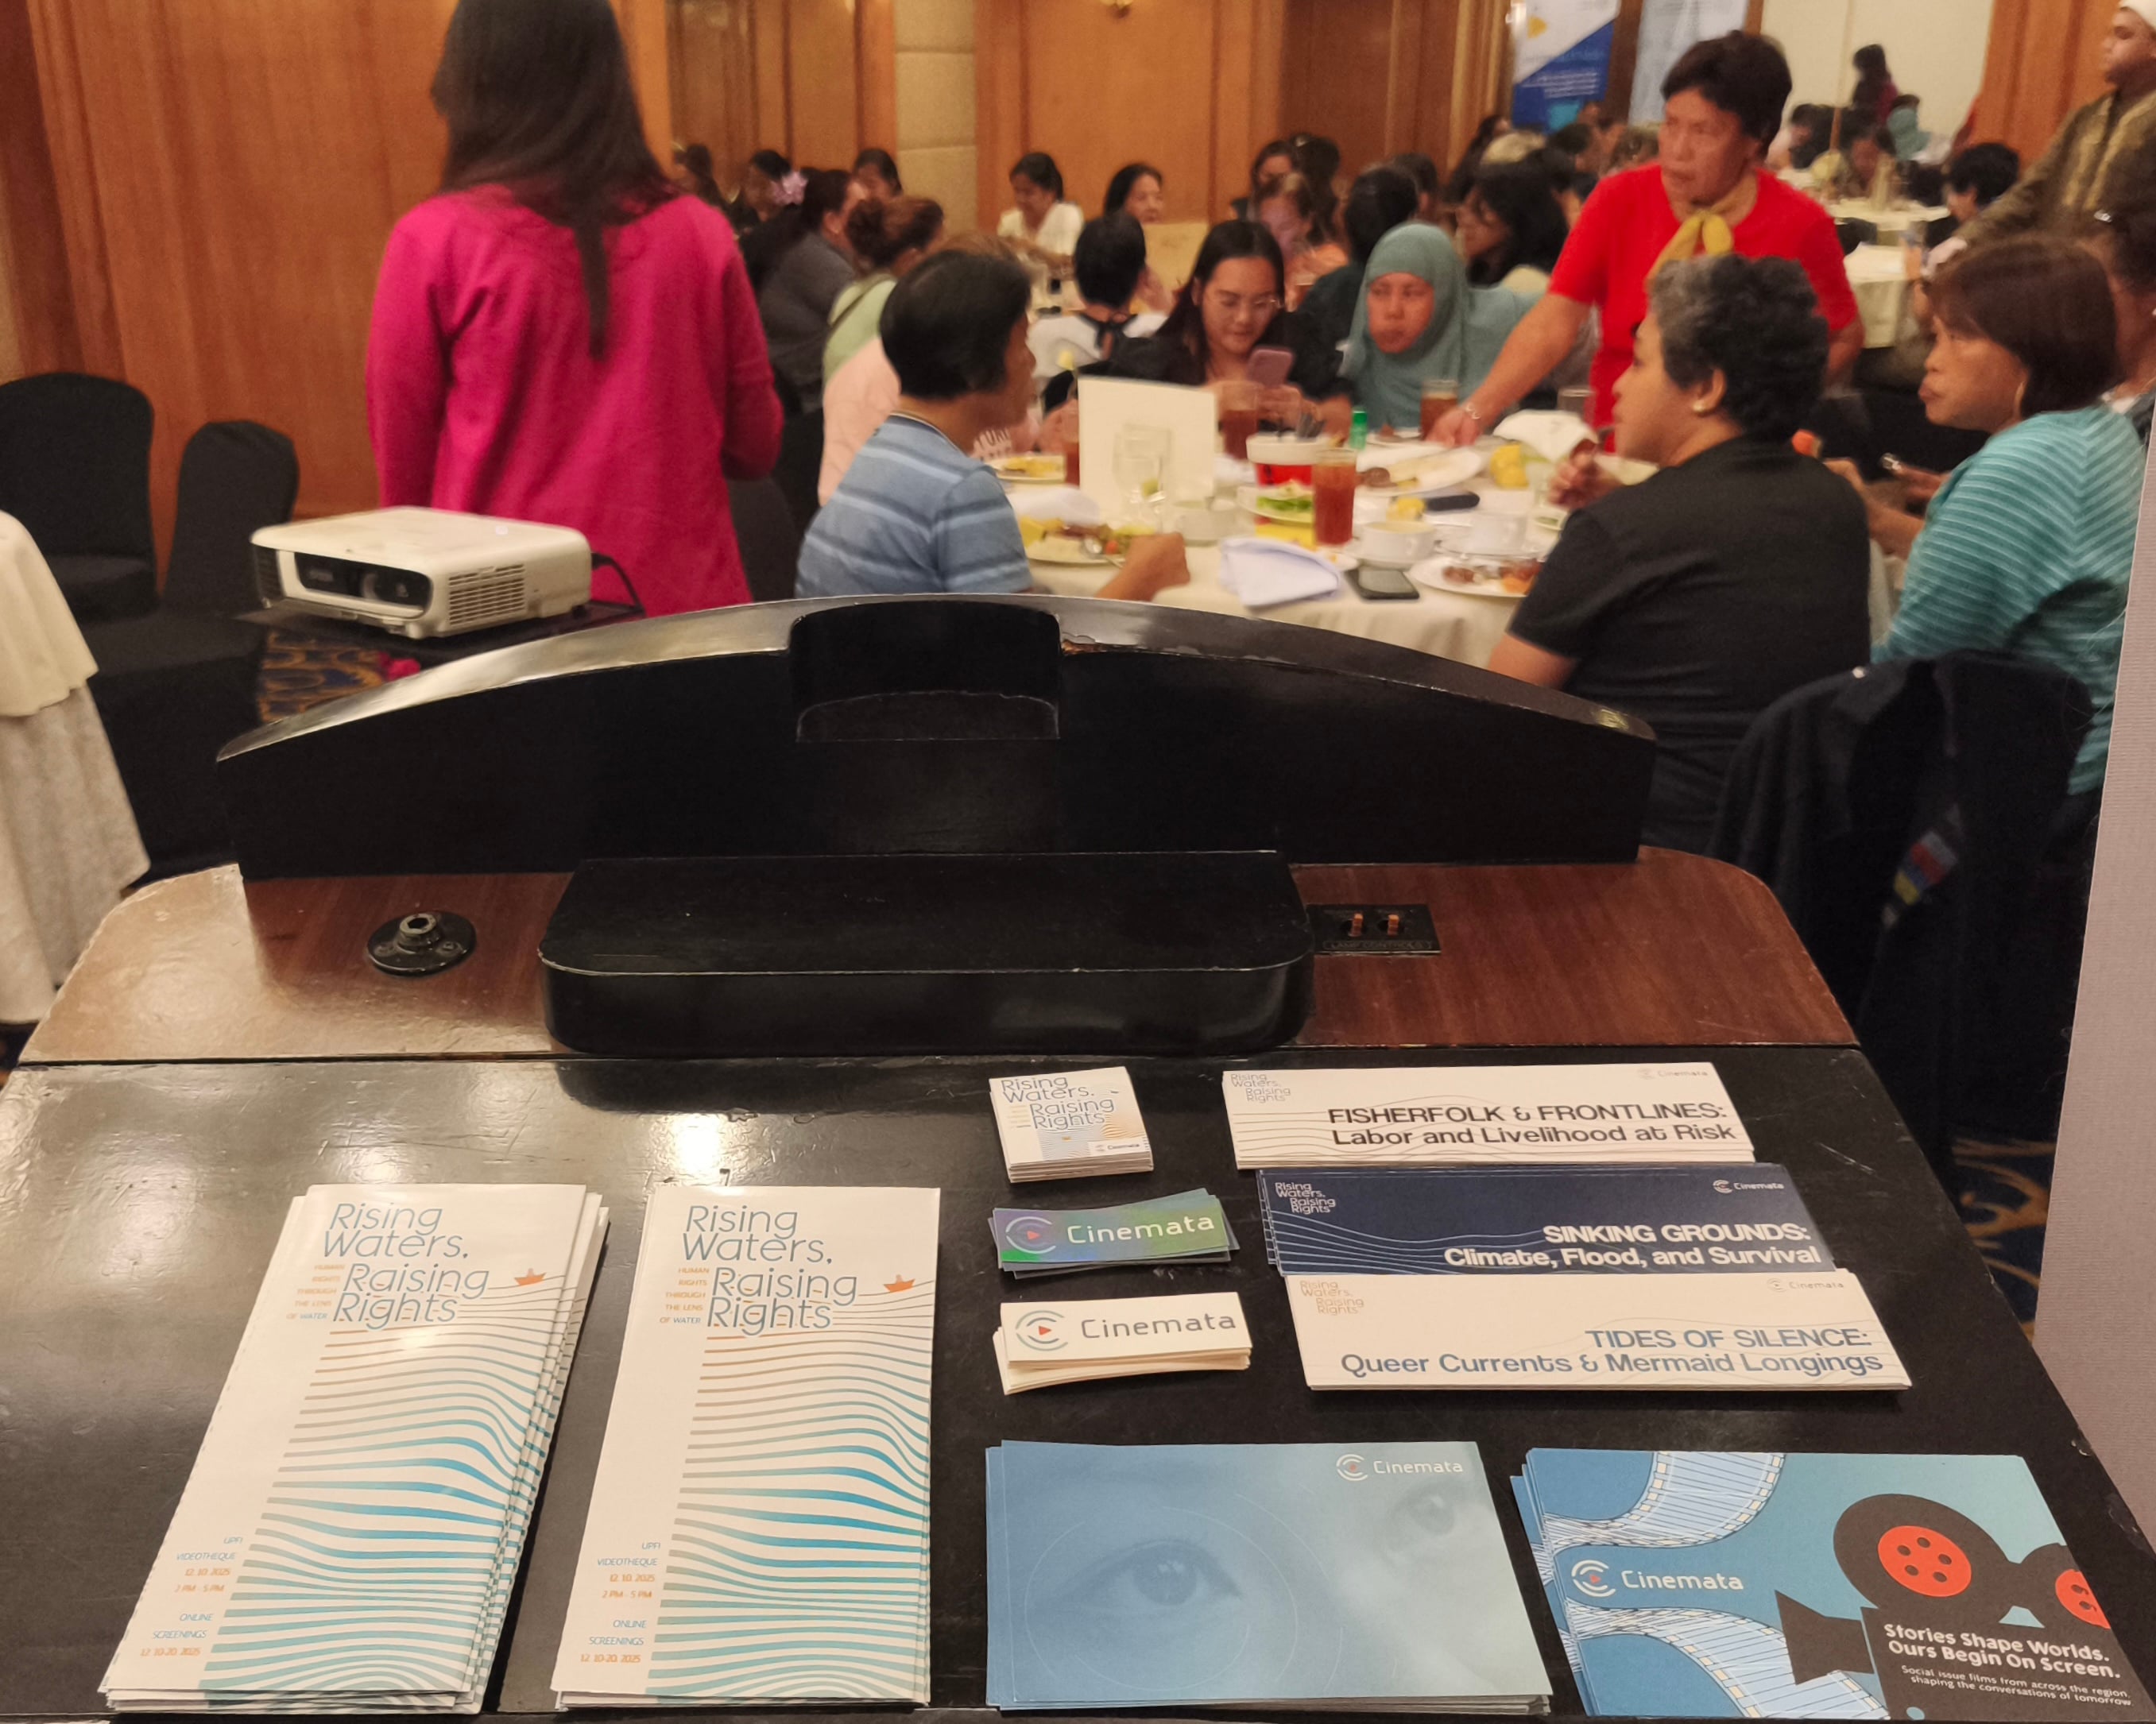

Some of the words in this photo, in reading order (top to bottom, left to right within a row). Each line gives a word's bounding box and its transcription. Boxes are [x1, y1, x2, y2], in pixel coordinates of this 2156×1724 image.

[1001, 1077, 1068, 1091] Rising
[1030, 1099, 1114, 1115] Raising
[1327, 1106, 1505, 1124] FISHERFOLK
[1513, 1107, 1531, 1122] &
[1537, 1103, 1727, 1121] FRONTLINES:
[1033, 1111, 1105, 1130] Rights
[1332, 1129, 1413, 1146] Labor
[1423, 1128, 1474, 1144] and
[1481, 1125, 1627, 1143] Livelihood
[1634, 1127, 1668, 1141] at
[1674, 1124, 1737, 1141] Risk
[1275, 1182, 1312, 1191] Rising
[1290, 1197, 1336, 1208] Raising
[1291, 1205, 1330, 1215] Rights
[329, 1203, 443, 1235] Rising
[686, 1204, 798, 1239] Rising
[1067, 1216, 1215, 1244] Cinemata
[1542, 1224, 1657, 1243] SINKING
[1661, 1223, 1811, 1243] GROUNDS:
[1444, 1247, 1558, 1269] Climate,
[1560, 1247, 1647, 1268] Flood,
[1652, 1247, 1705, 1266] and
[1709, 1246, 1821, 1264] Survival
[343, 1262, 490, 1300] Raising
[714, 1267, 857, 1306] Raising
[333, 1293, 458, 1330] Rights
[707, 1296, 832, 1336] Rights
[1081, 1313, 1237, 1339] Cinemata
[1585, 1329, 1677, 1348] TIDES
[1683, 1330, 1724, 1348] OF
[1733, 1328, 1872, 1347] SILENCE:
[1341, 1354, 1430, 1378] Queer
[1438, 1353, 1573, 1373] Currents
[1579, 1354, 1598, 1373] &
[1605, 1353, 1735, 1373] Mermaid
[1740, 1353, 1883, 1377] Longings
[1373, 1460, 1463, 1474] Cinemata
[176, 1552, 236, 1561] VIDEOTHEQUE
[597, 1558, 658, 1567] VIDEOTHEQUE
[1621, 1570, 1744, 1590] Cinemata
[153, 1630, 207, 1639] SCREENINGS
[589, 1637, 644, 1645] SCREENINGS
[1883, 1624, 1956, 1645] Stories
[1960, 1633, 2024, 1653] Shape
[2026, 1640, 2110, 1662] Worlds.
[1888, 1640, 1937, 1658] Ours
[1942, 1646, 2002, 1667] Begin
[2006, 1653, 2036, 1670] On
[2040, 1657, 2121, 1679] Screen.
[1901, 1664, 1934, 1677] Social
[1938, 1669, 1965, 1680] issue
[1969, 1672, 1997, 1683] films
[2000, 1676, 2027, 1687] from
[2031, 1680, 2066, 1691] across
[2069, 1684, 2088, 1695] the
[1910, 1675, 1955, 1690] shaping
[1957, 1680, 1976, 1690] the
[1979, 1683, 2057, 1699] conversations
[2059, 1691, 2071, 1701] of
